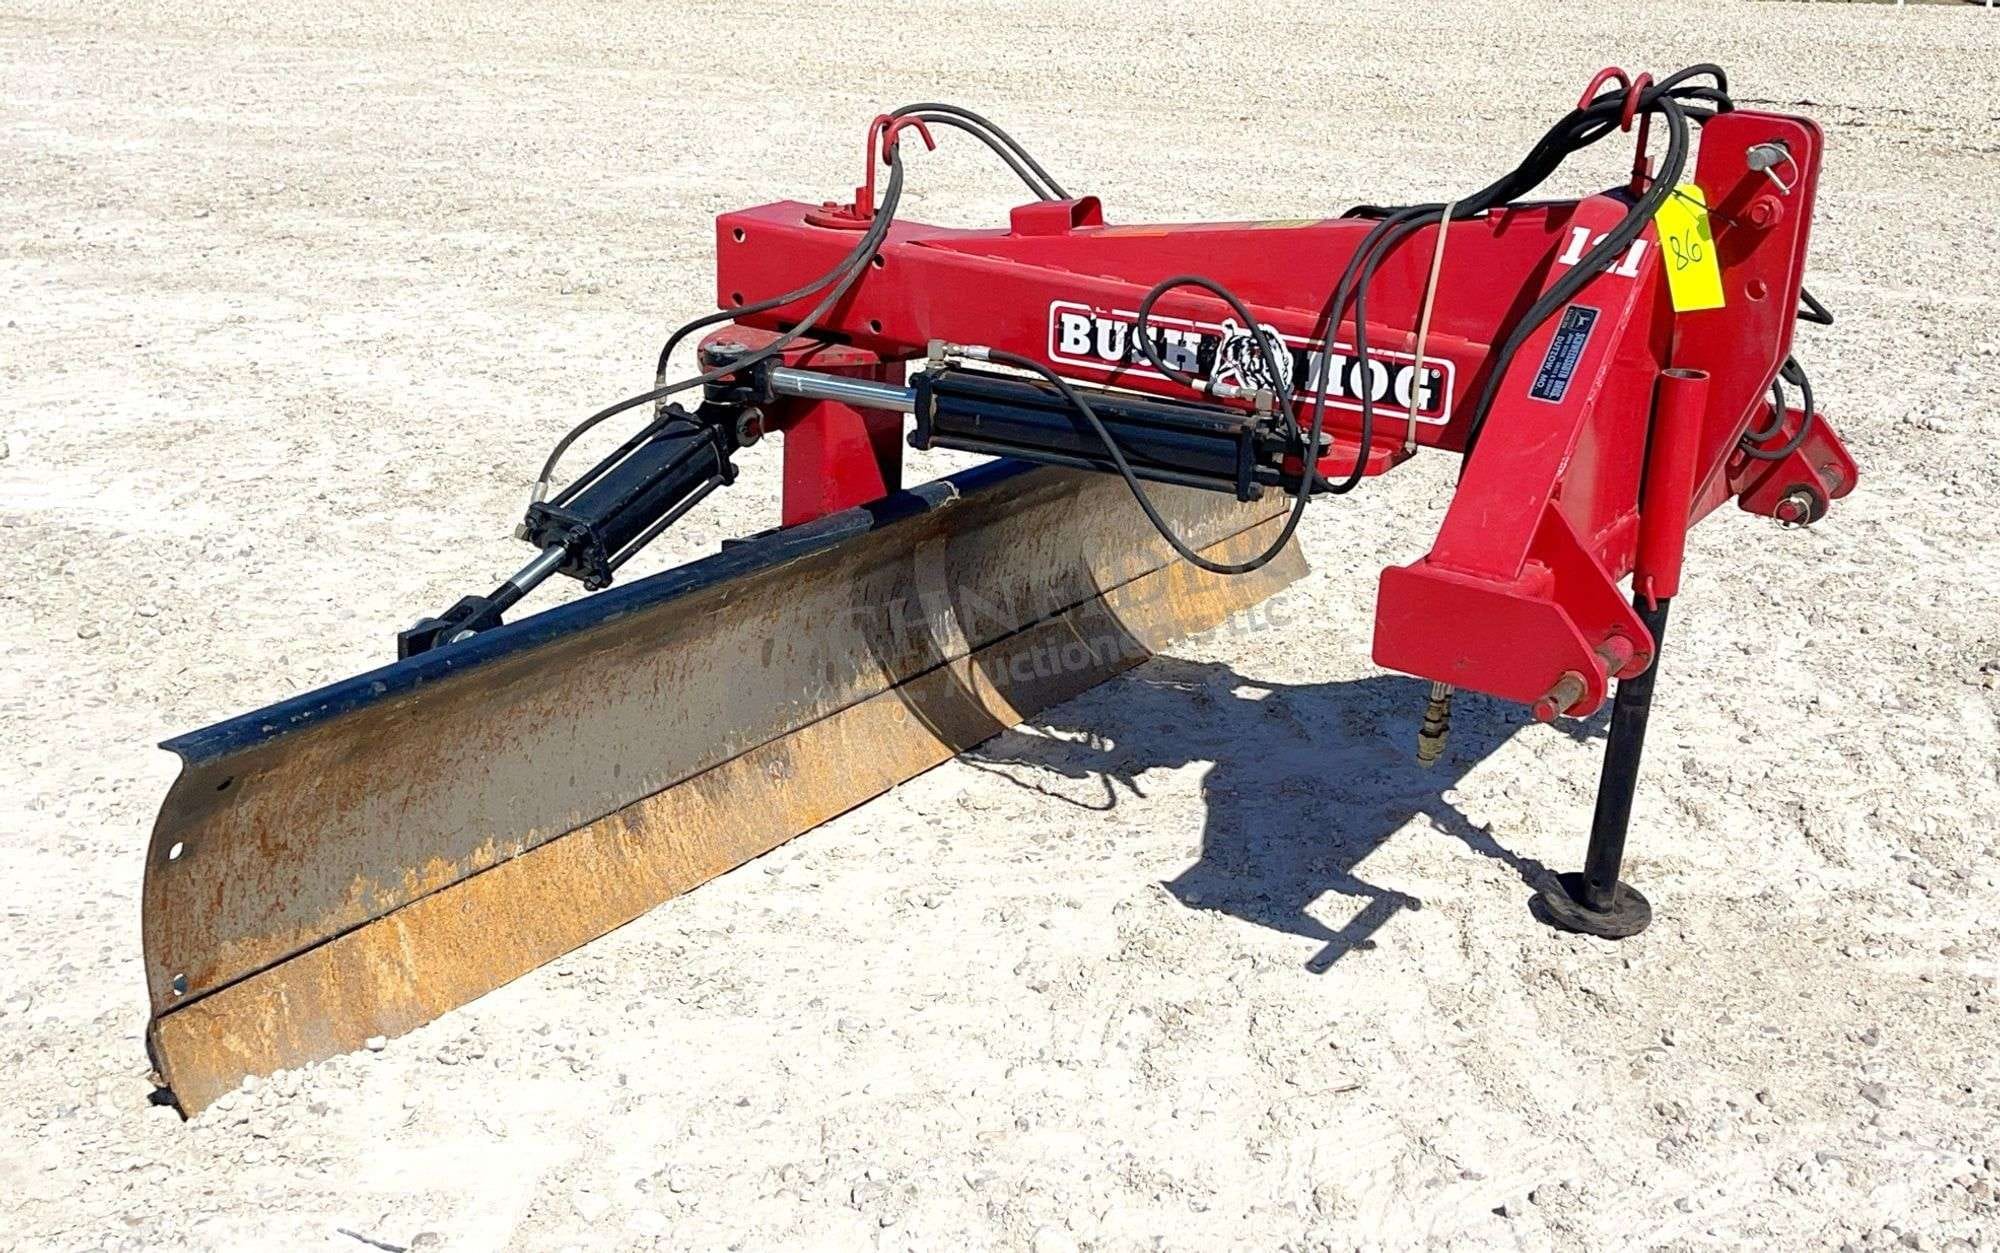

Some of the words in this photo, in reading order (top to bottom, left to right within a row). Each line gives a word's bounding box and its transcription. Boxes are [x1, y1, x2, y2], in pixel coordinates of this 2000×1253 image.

[1558, 226, 1648, 278] 11
[1669, 228, 1703, 271] 86
[1060, 312, 1201, 374] BUSH
